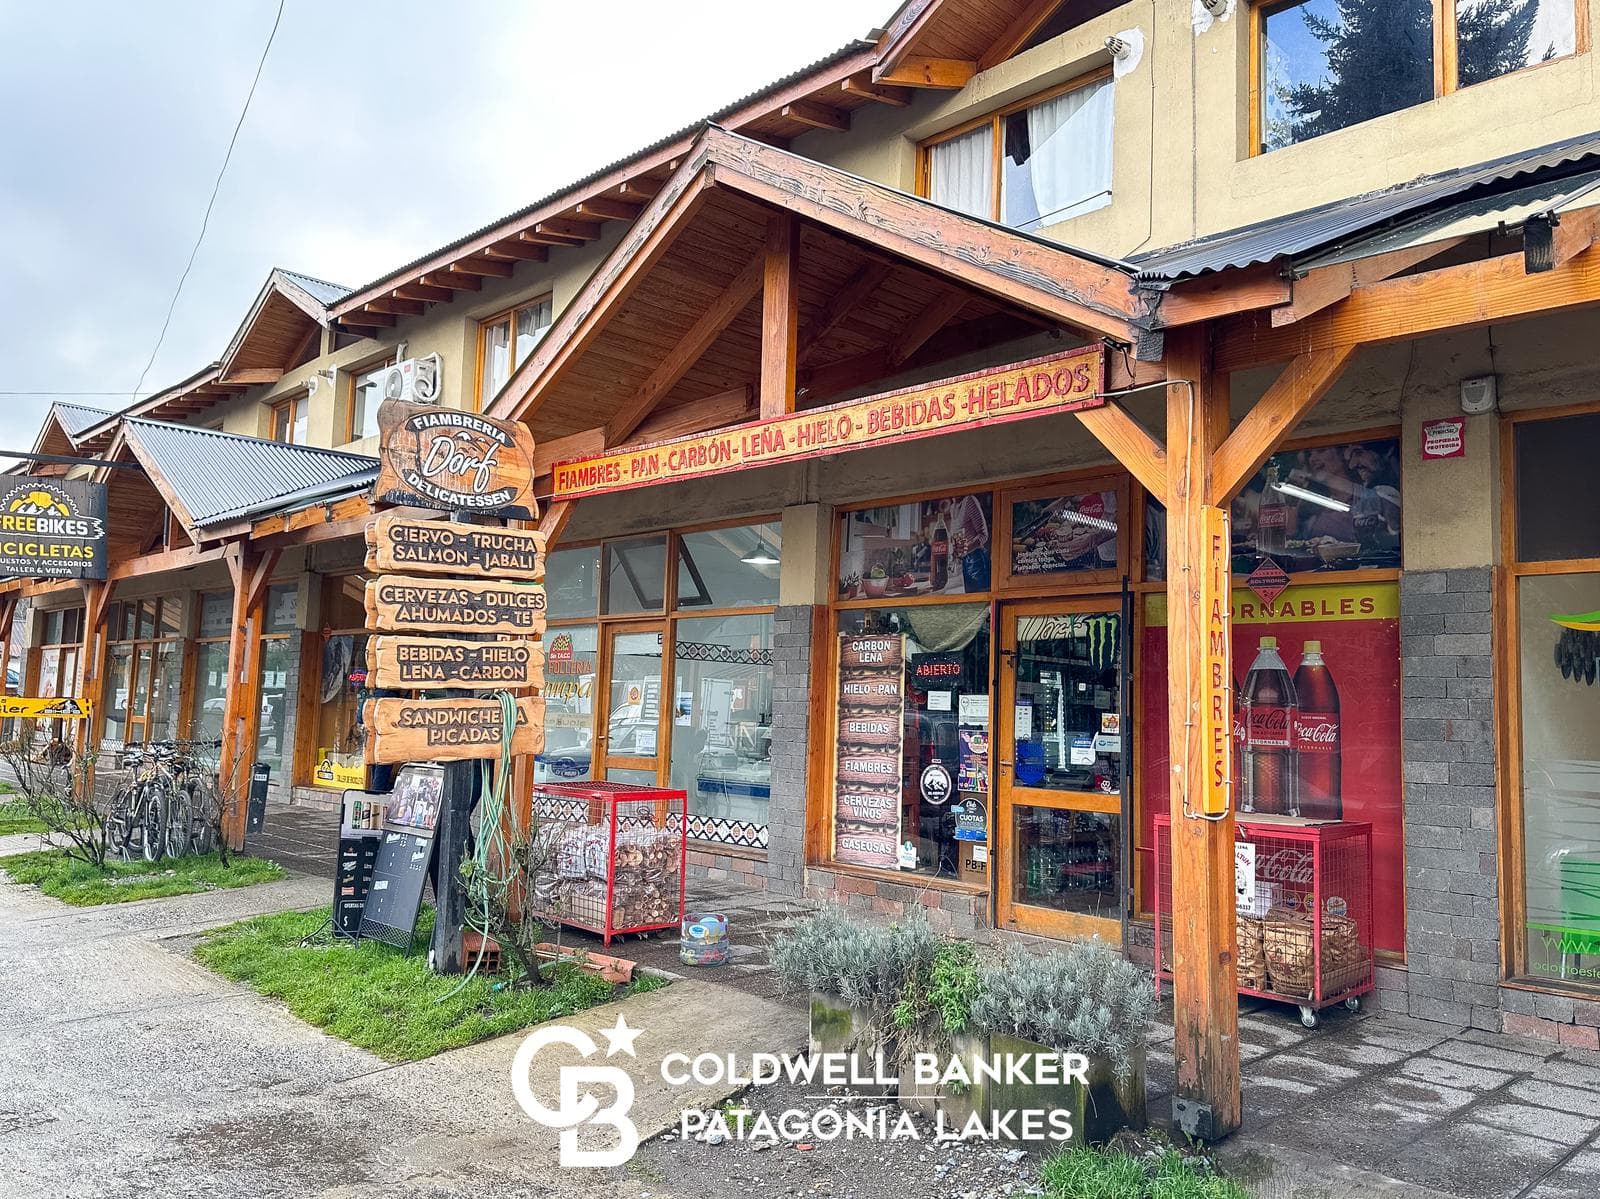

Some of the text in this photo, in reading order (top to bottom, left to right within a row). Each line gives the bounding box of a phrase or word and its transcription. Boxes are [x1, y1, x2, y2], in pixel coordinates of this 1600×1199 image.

[414, 413, 507, 444] FIAMBRERIA
[558, 461, 621, 490] FIAMBRES
[631, 454, 659, 479] PAN
[742, 426, 786, 458] LEÑA
[797, 415, 851, 447] HIELO
[867, 393, 955, 434] BEBIDAS
[422, 434, 500, 492] Dorf
[406, 473, 511, 507] DELICATESSEN
[389, 527, 454, 545] CIERVO
[473, 534, 536, 553] TRUCHA
[41, 559, 93, 568] ACCESORIOS
[395, 546, 468, 564] SALMON
[485, 553, 533, 569] JABALI
[381, 587, 469, 605] CERVEZAS
[486, 593, 545, 609] DULCES
[398, 605, 496, 623] AHUMADOS
[514, 611, 532, 625] TE
[1232, 598, 1375, 617] RNABLES
[399, 646, 464, 662] BEBIDAS
[482, 647, 528, 662] HIELO
[852, 640, 891, 652] CARBON
[916, 663, 961, 676] ABIERTO
[1209, 535, 1224, 787] FIAMBRES
[402, 662, 444, 679] LEÑA
[843, 685, 871, 695] HIELO
[878, 684, 897, 695] PAN
[402, 709, 526, 726] SANDWICHEA
[430, 728, 501, 743] PICADAS
[849, 722, 889, 734] BEBIDAS
[845, 761, 893, 774] FIAMBRES
[843, 795, 893, 809] CERVEZAS
[853, 807, 882, 819] VINOS
[842, 838, 893, 854] GASEOSAS
